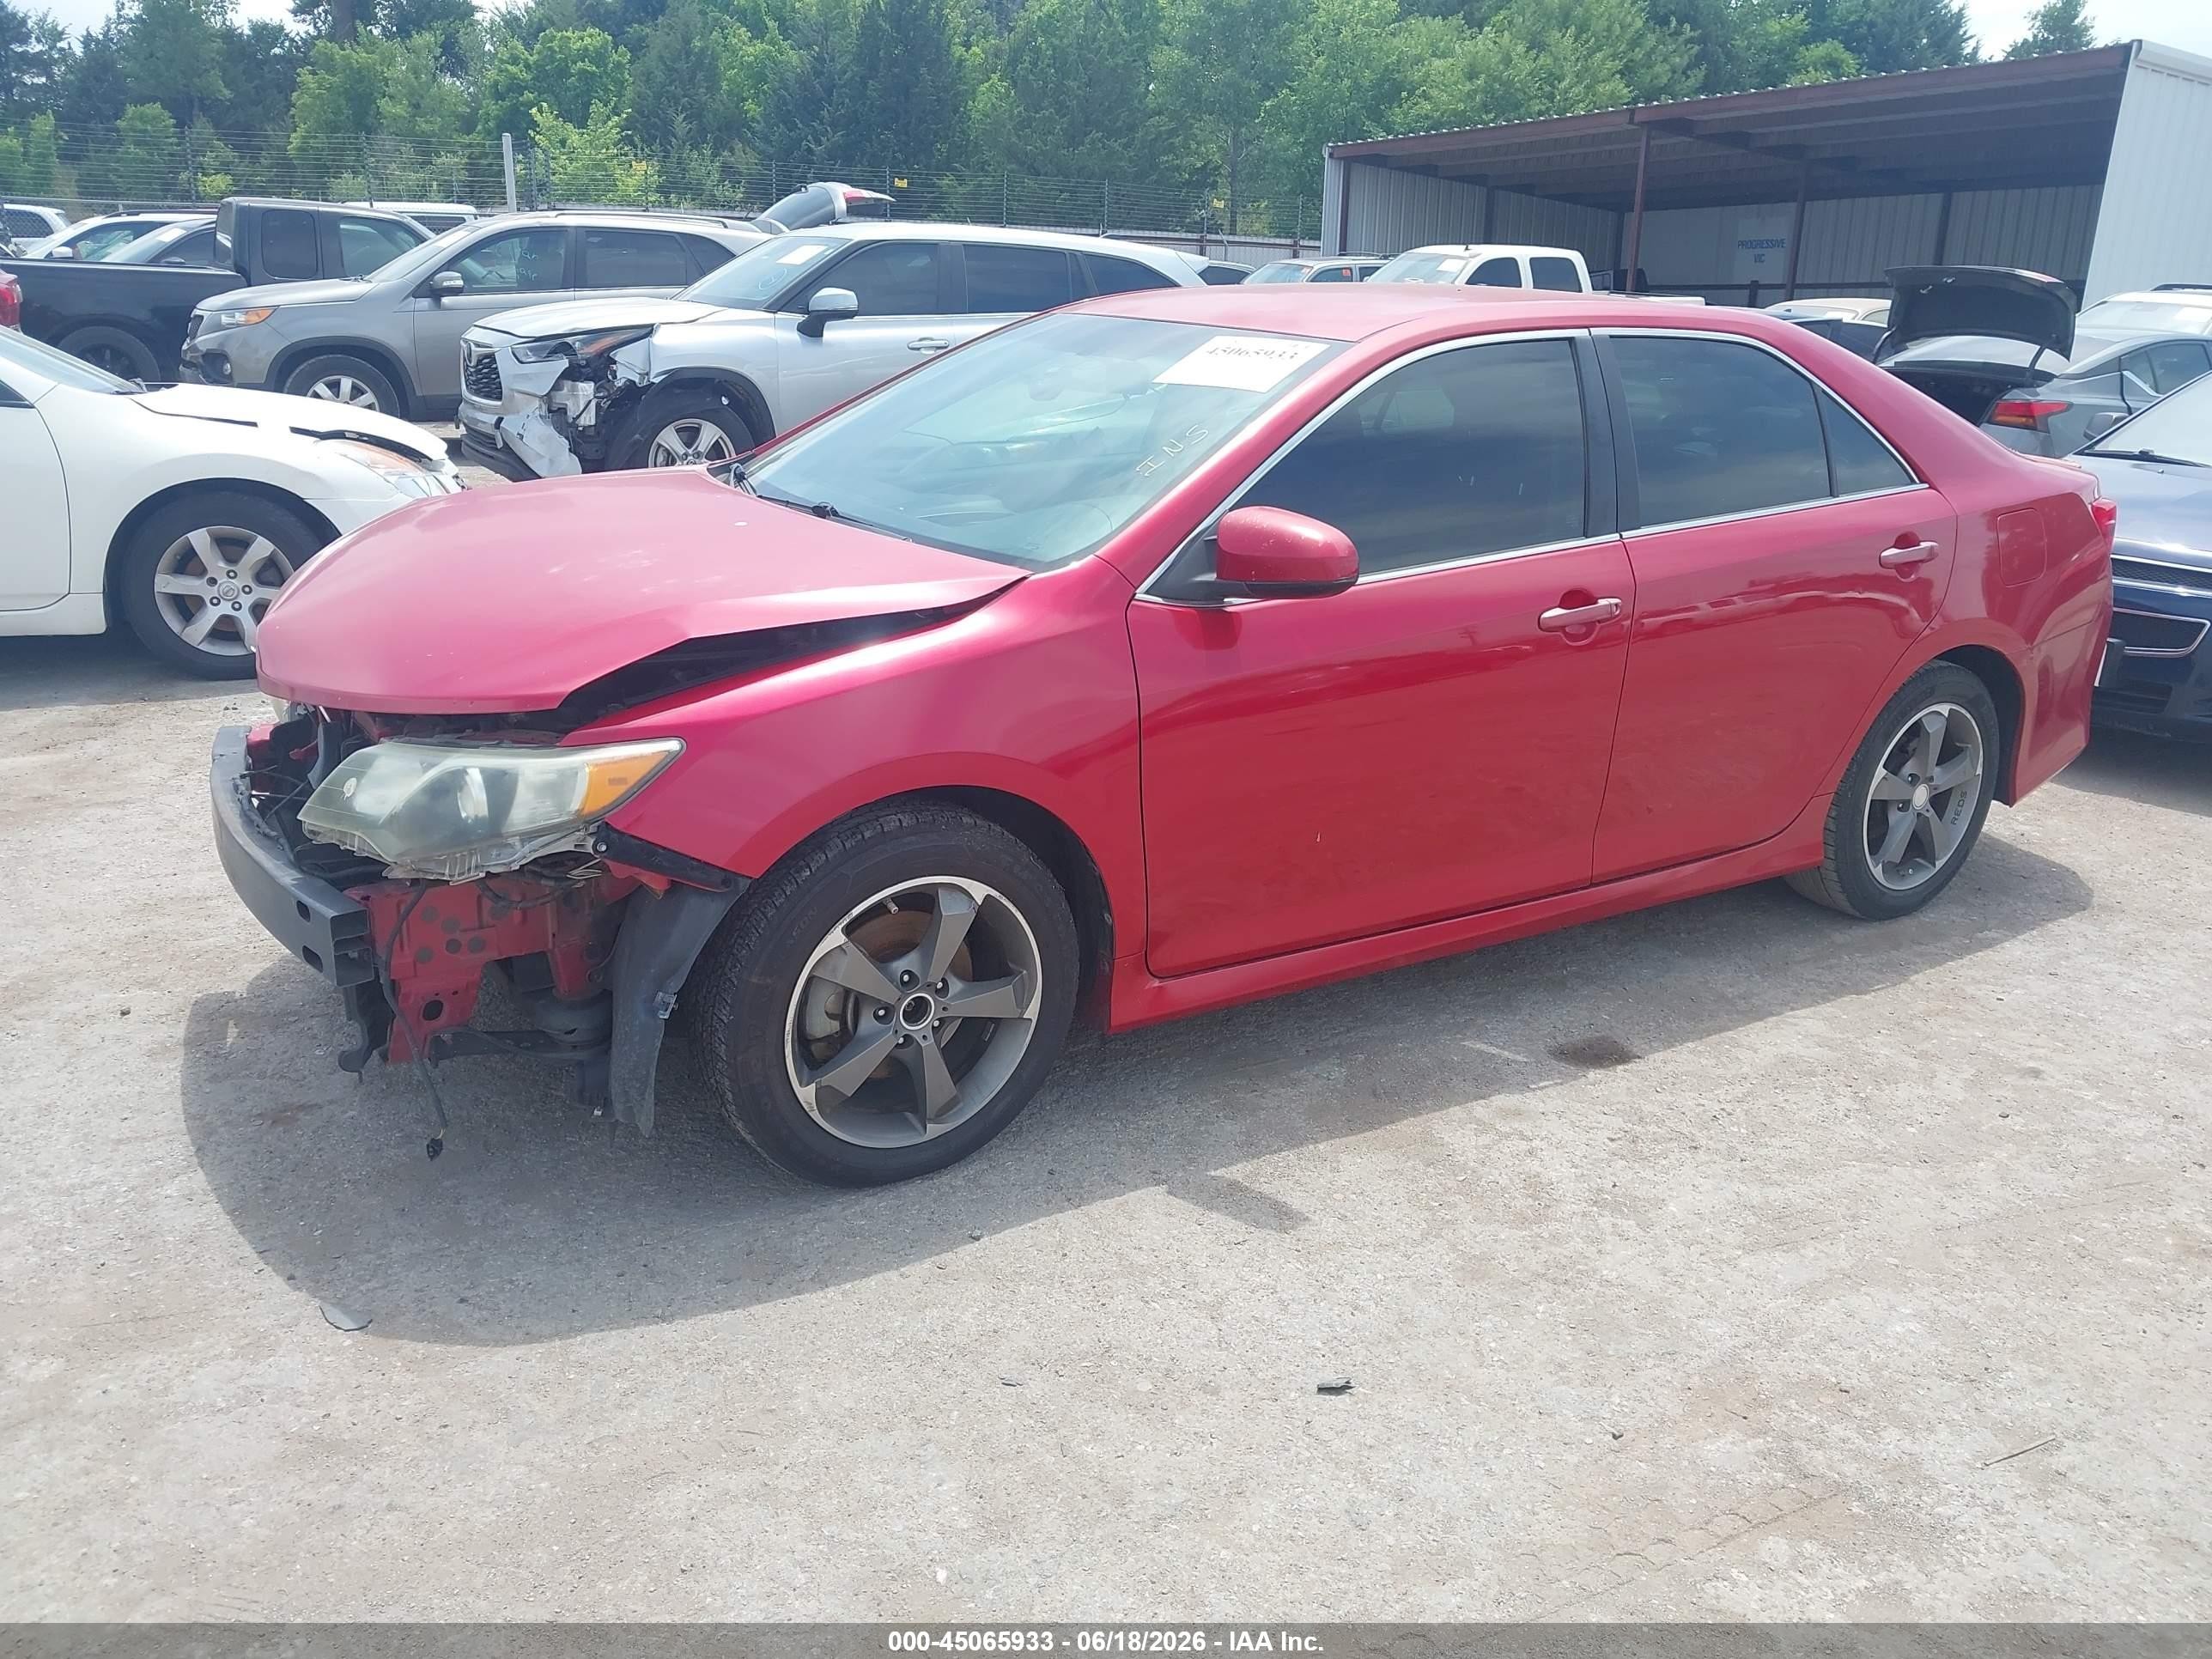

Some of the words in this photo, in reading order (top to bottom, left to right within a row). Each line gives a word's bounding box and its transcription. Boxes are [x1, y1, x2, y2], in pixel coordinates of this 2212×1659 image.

[1737, 238, 1787, 249] PROGRESSIVE
[1753, 253, 1765, 264] VIC
[1134, 423, 1210, 477] INS
